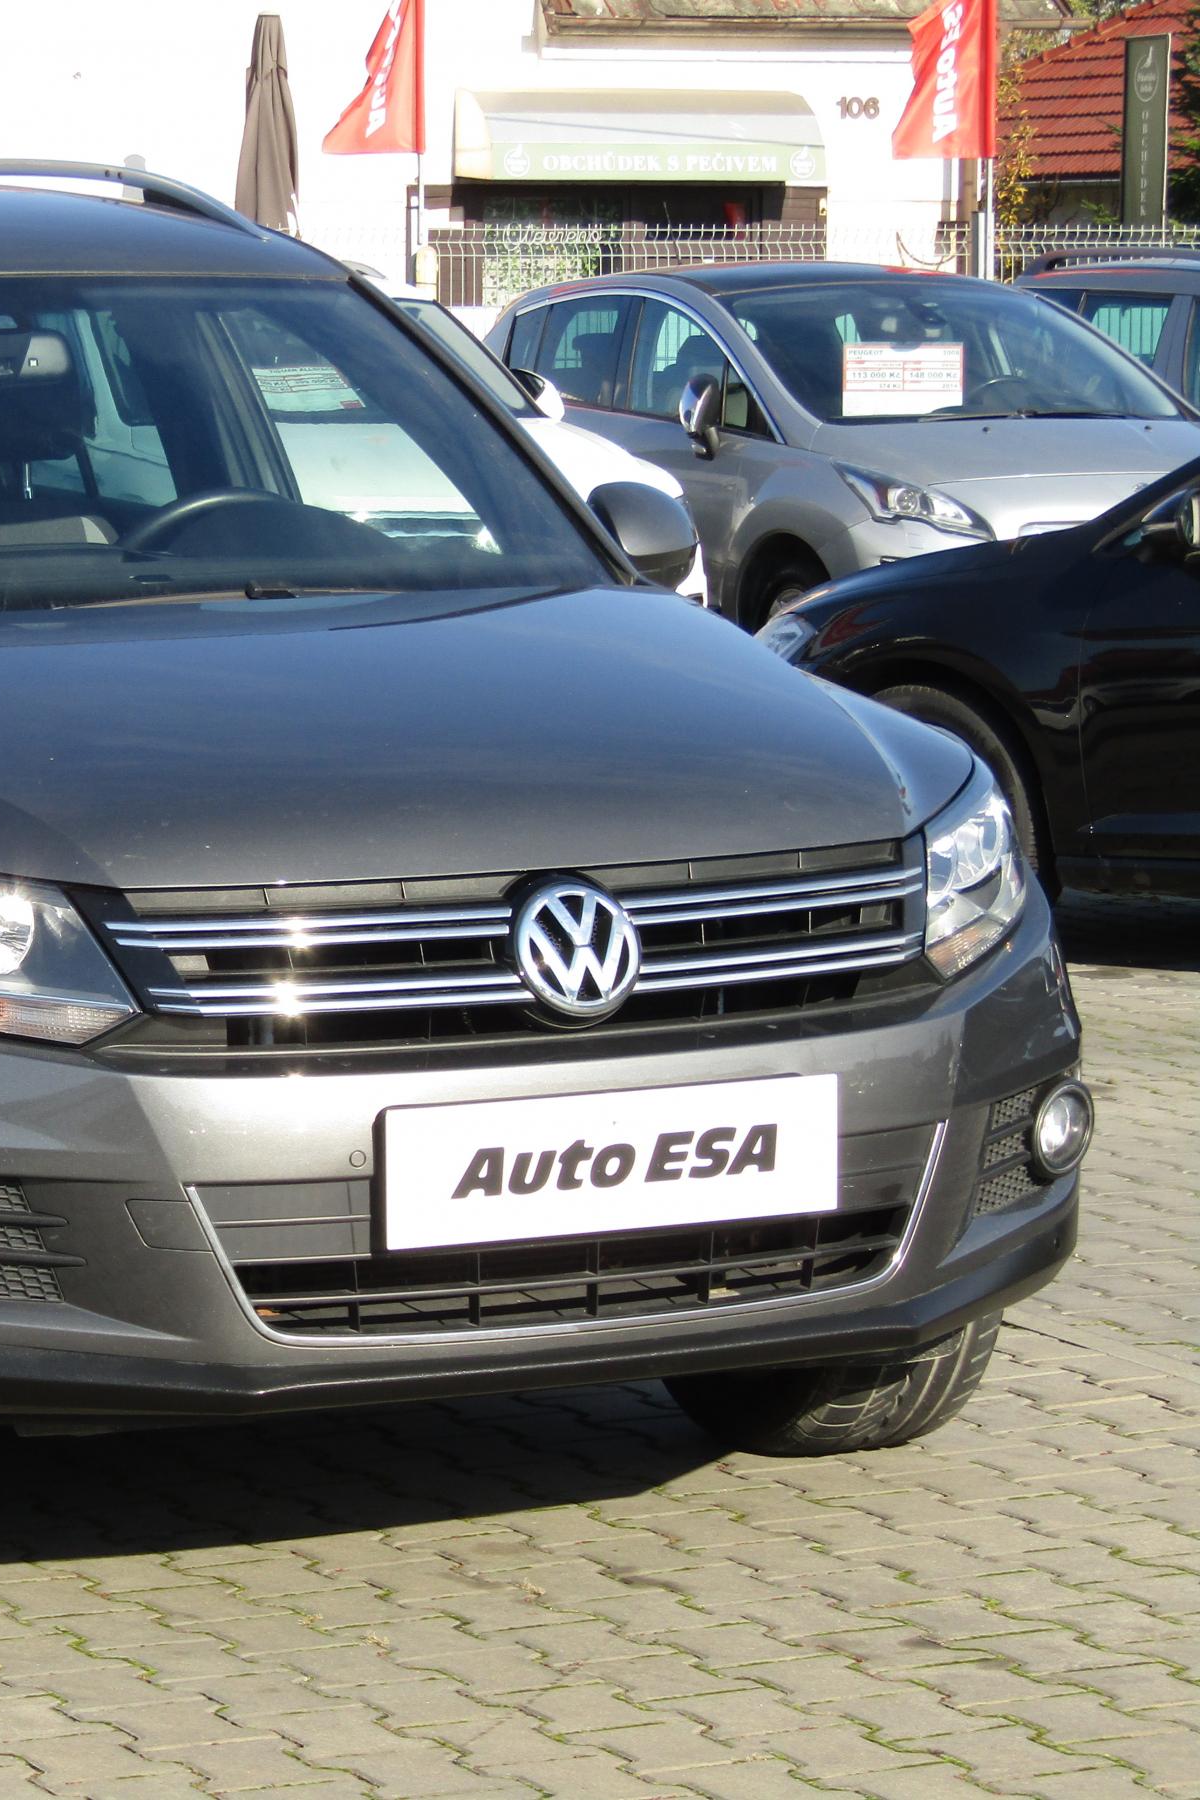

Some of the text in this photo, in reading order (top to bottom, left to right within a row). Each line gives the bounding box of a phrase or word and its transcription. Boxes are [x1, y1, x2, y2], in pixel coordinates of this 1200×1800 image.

[836, 96, 880, 120] 106
[543, 151, 661, 172] OBCHŮDEK
[667, 155, 679, 173] S
[686, 152, 777, 173] PEČIVEM
[451, 1123, 778, 1200] Auto ESA
